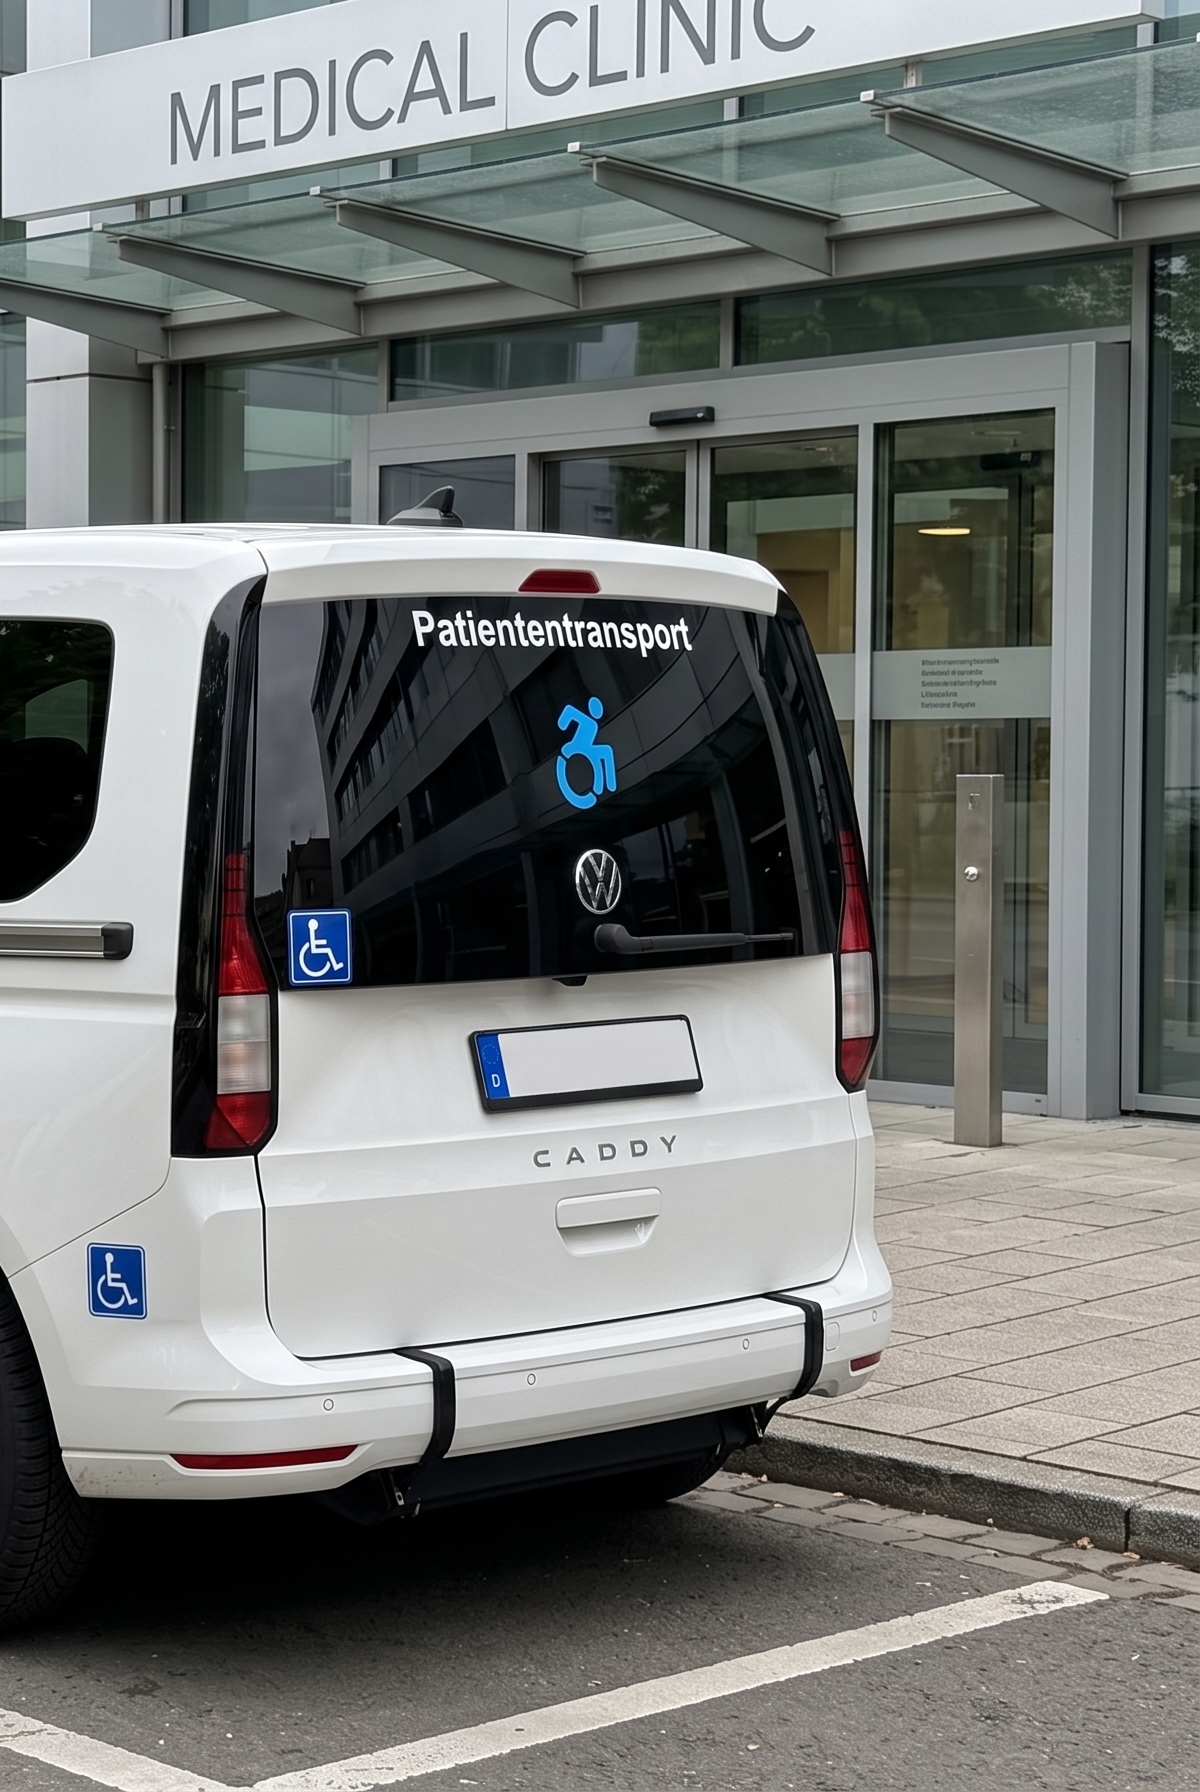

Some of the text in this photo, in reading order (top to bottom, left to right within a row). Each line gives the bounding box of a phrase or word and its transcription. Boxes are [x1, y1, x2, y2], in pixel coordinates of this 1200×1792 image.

[170, 0, 816, 166] MEDICAL CLINIC
[411, 610, 693, 658] Patiententransport
[491, 1073, 501, 1088] D
[533, 1134, 677, 1168] CADDY
